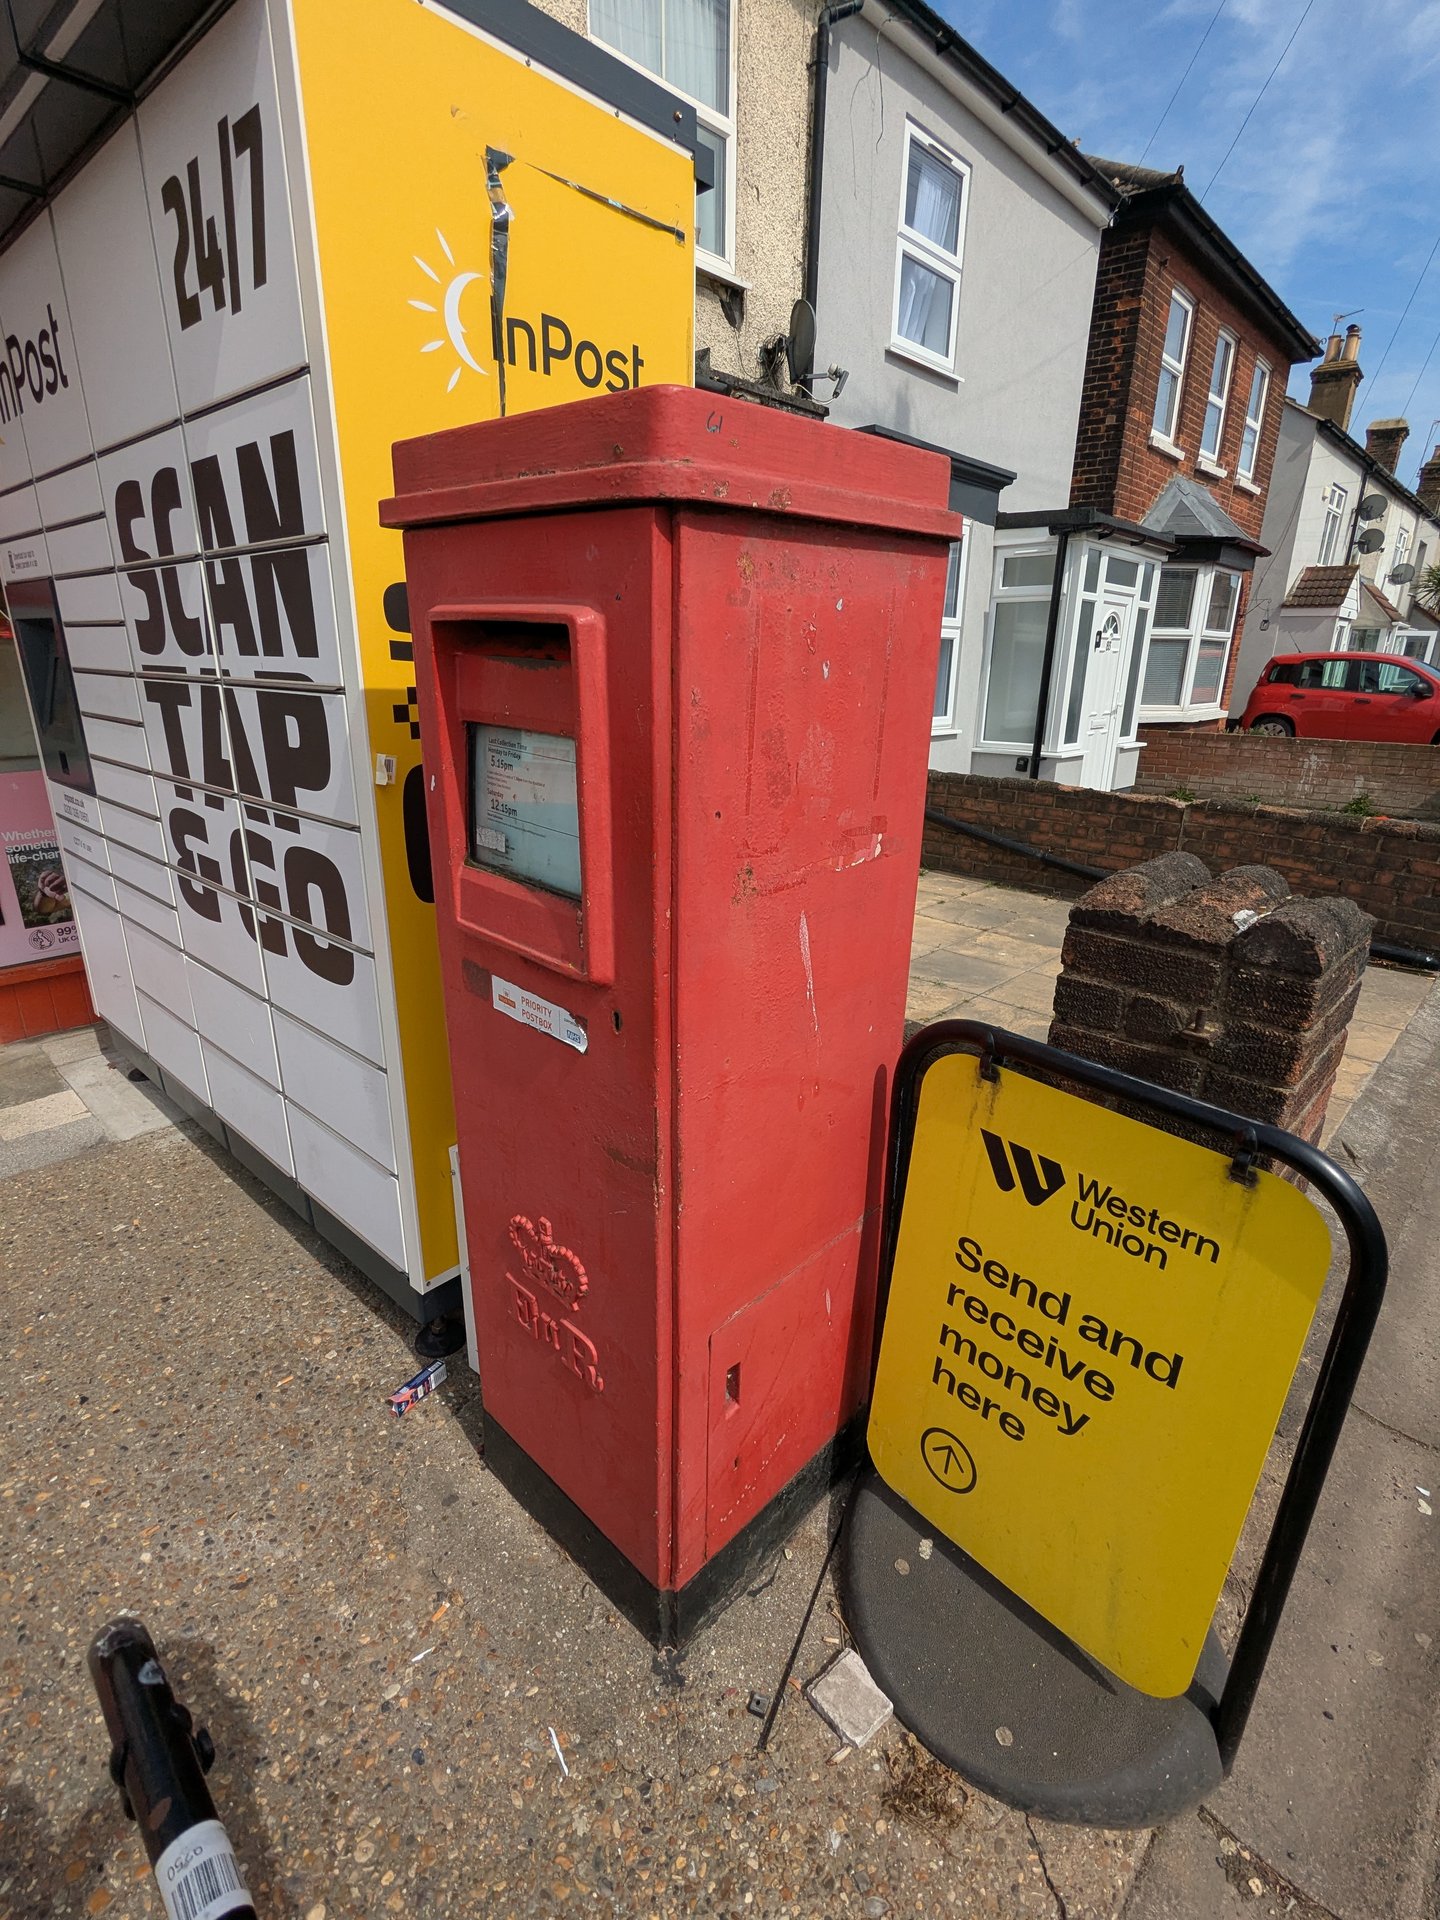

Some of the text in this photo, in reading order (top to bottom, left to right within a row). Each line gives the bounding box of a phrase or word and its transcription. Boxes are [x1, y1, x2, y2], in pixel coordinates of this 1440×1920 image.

[161, 102, 267, 331] 24/7
[0, 303, 69, 424] nPost
[115, 429, 319, 656] SCAN
[142, 664, 331, 834] TAP
[490, 755, 514, 772] 5.15pm
[508, 750, 521, 761] Friday
[490, 798, 518, 817] 12.15pm
[229, 828, 354, 986] GO
[521, 996, 552, 1018] PRIORITY
[521, 1008, 553, 1031] POSTBOX
[1070, 1200, 1168, 1271] Union
[1078, 1172, 1221, 1264] Western
[946, 1282, 1115, 1402] receive
[954, 1236, 1184, 1390] Send and
[931, 1355, 1026, 1442] here
[938, 1323, 1091, 1436] money
